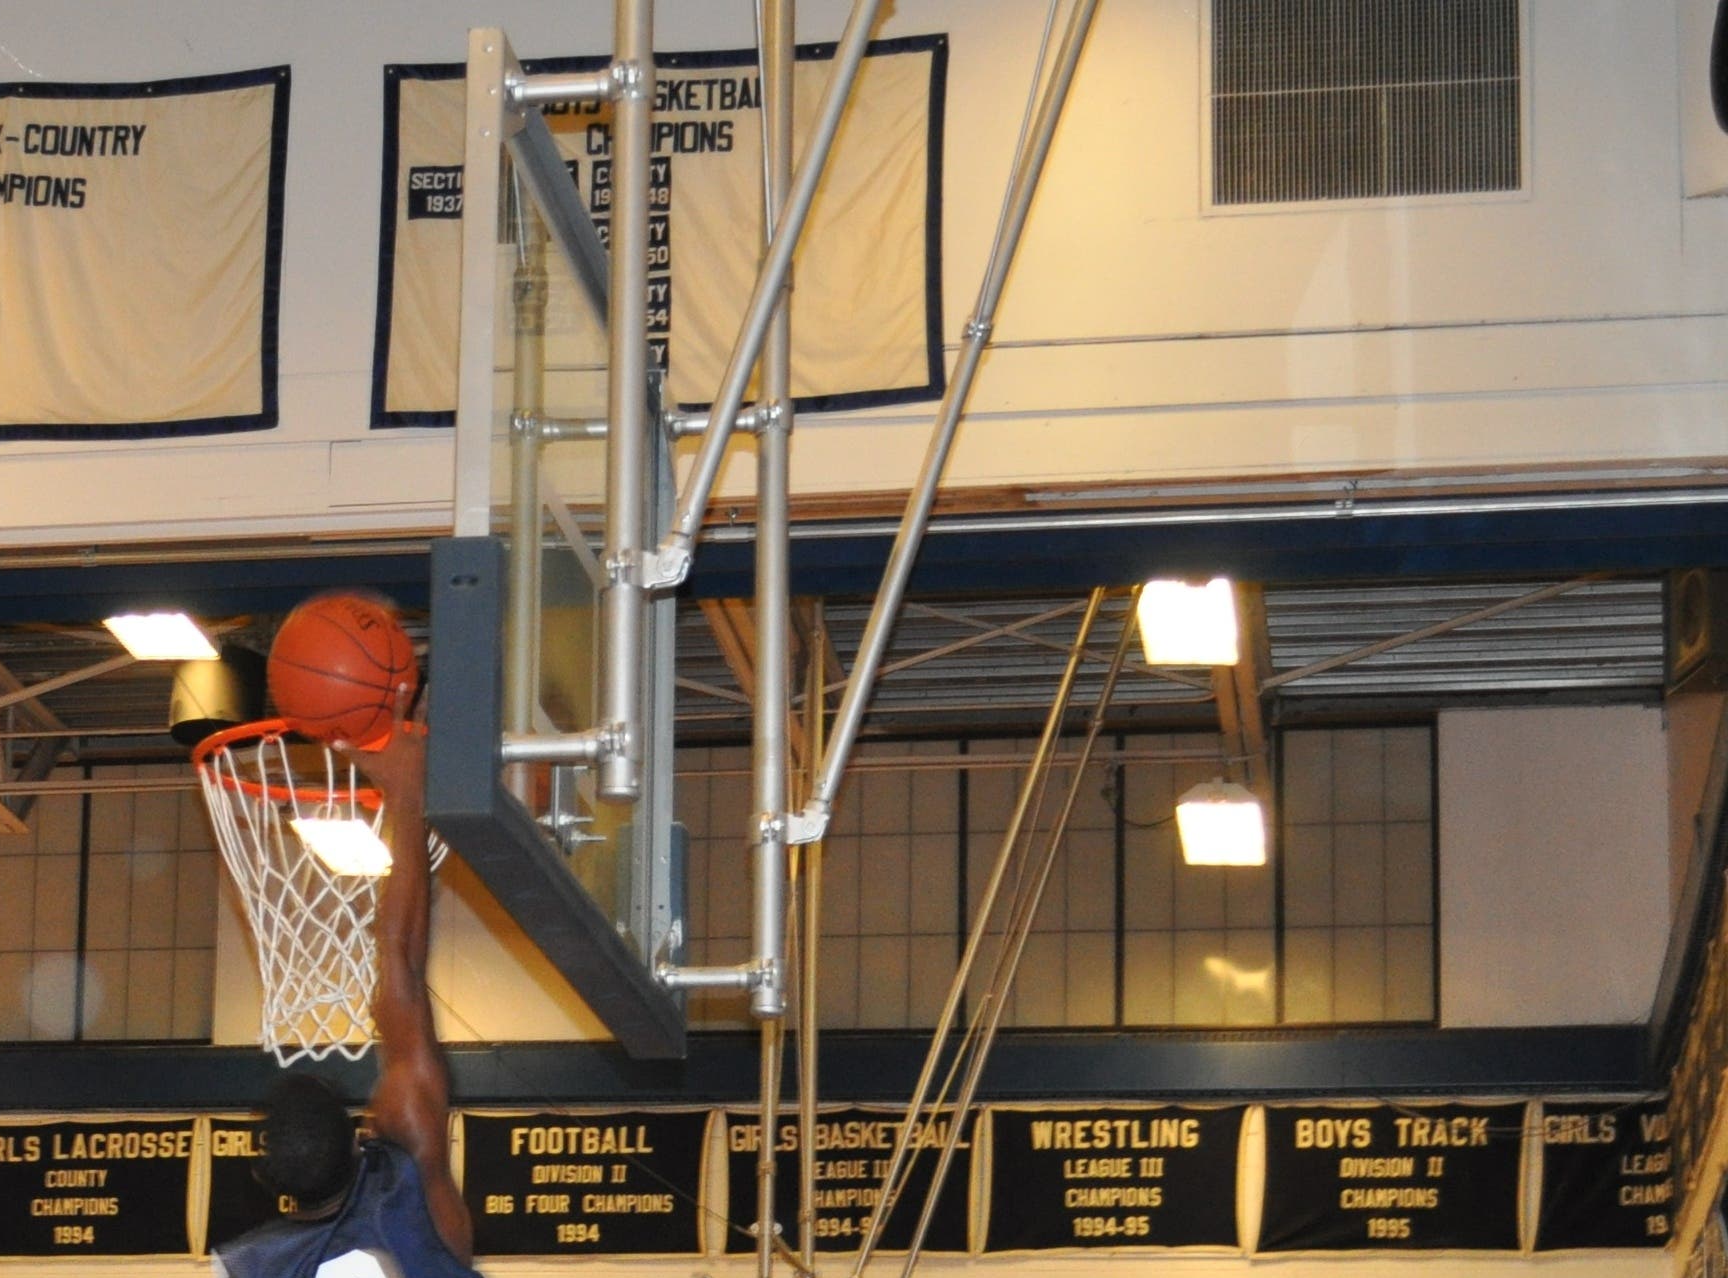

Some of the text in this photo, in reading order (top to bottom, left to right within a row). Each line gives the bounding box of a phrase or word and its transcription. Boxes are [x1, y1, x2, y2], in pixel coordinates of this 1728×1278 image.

[1031, 1119, 1200, 1150] WRESTLING
[1295, 1117, 1490, 1149] BOYS TRACK
[1543, 1114, 1617, 1145] GIRLS
[52, 1130, 193, 1160] LACROSSE
[510, 1125, 654, 1156] FOOTBALL
[531, 1165, 604, 1185] DIVISION
[1064, 1158, 1132, 1179] LEAGUE
[1339, 1157, 1414, 1178] DIVISION
[44, 1169, 108, 1188] COUNTY
[30, 1197, 120, 1217] CHAMPIONS
[484, 1194, 675, 1214] BIG FOUR CHAMPIONS
[1064, 1188, 1163, 1207] CHAMPIONS
[1339, 1189, 1438, 1210] CHAMPIONS
[52, 1225, 95, 1244] 1994
[556, 1223, 600, 1243] 1994
[1072, 1216, 1150, 1237] 1994-95
